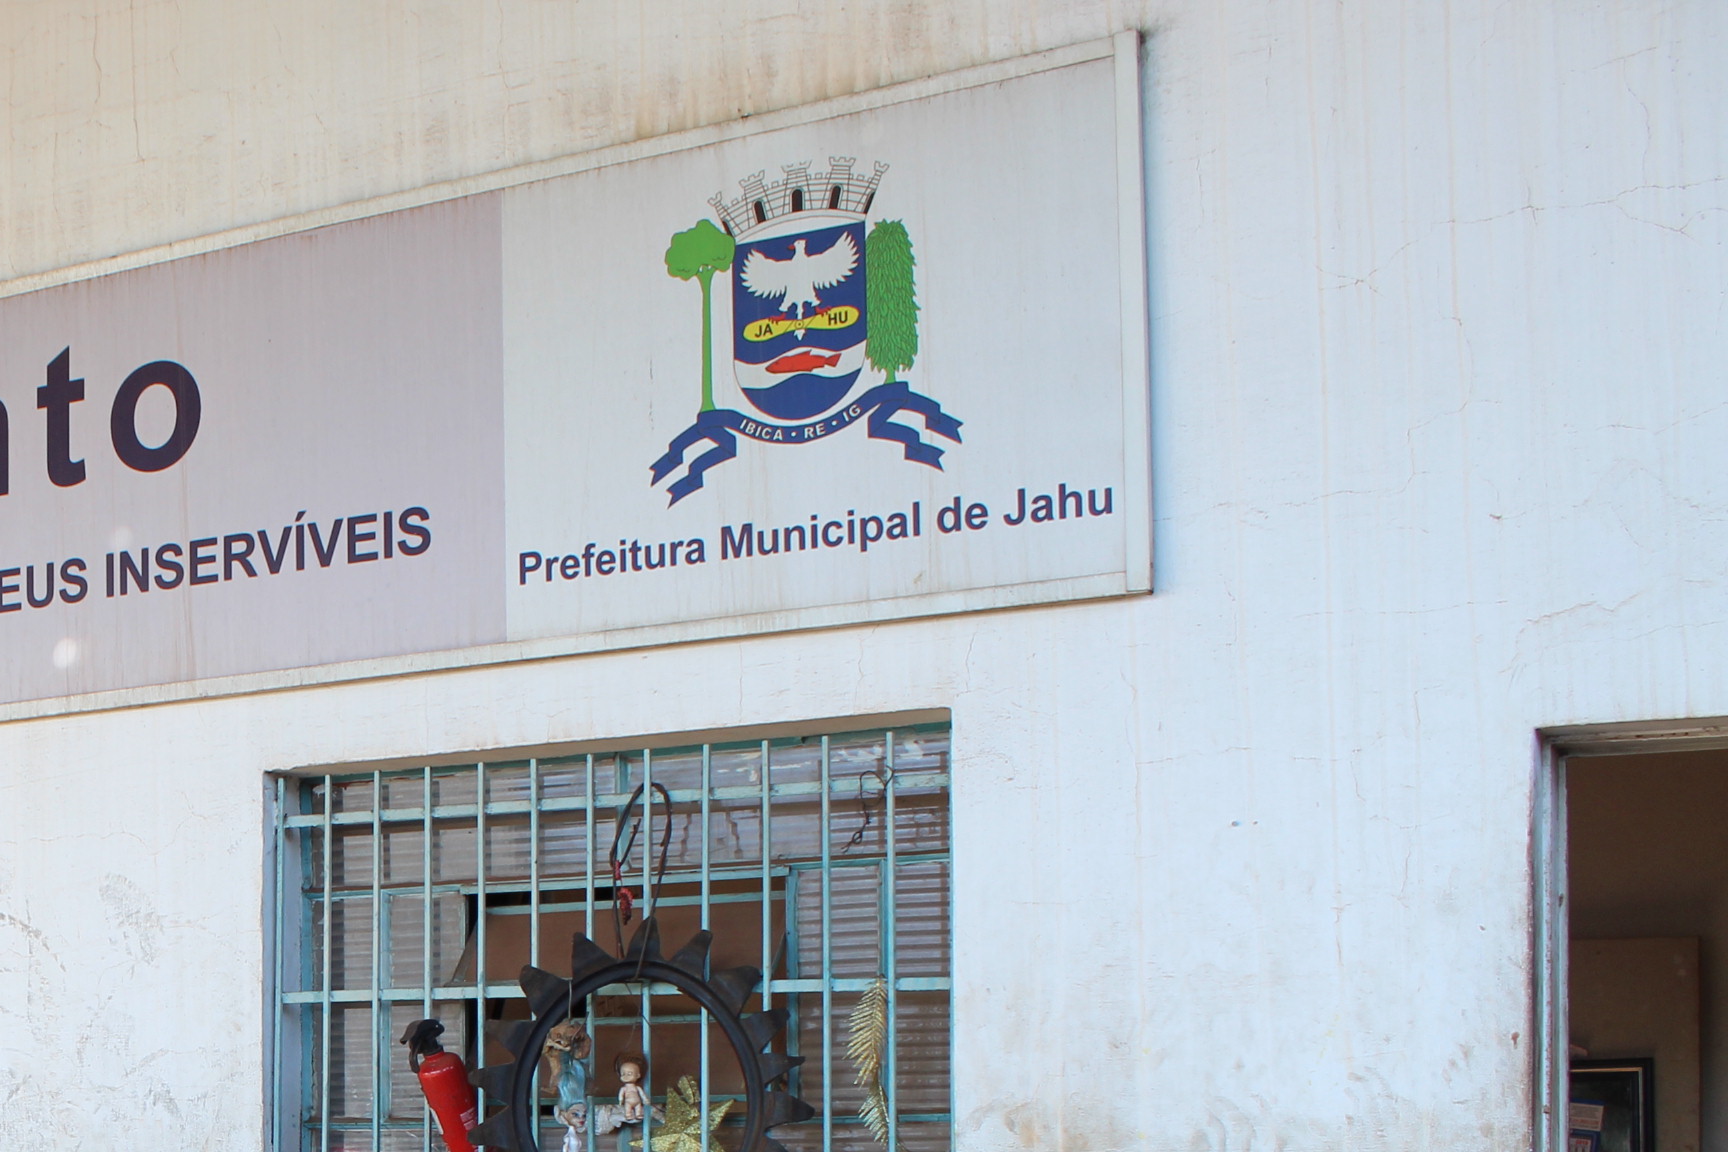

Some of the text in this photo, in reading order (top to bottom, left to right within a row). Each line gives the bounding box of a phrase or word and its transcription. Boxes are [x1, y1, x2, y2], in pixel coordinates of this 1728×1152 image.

[754, 310, 849, 338] JA HU
[803, 423, 826, 439] RE
[842, 403, 862, 422] IG
[105, 505, 431, 598] INSERVÍVEIS
[519, 483, 1114, 586] Prefeitura Municipal de Jahu
